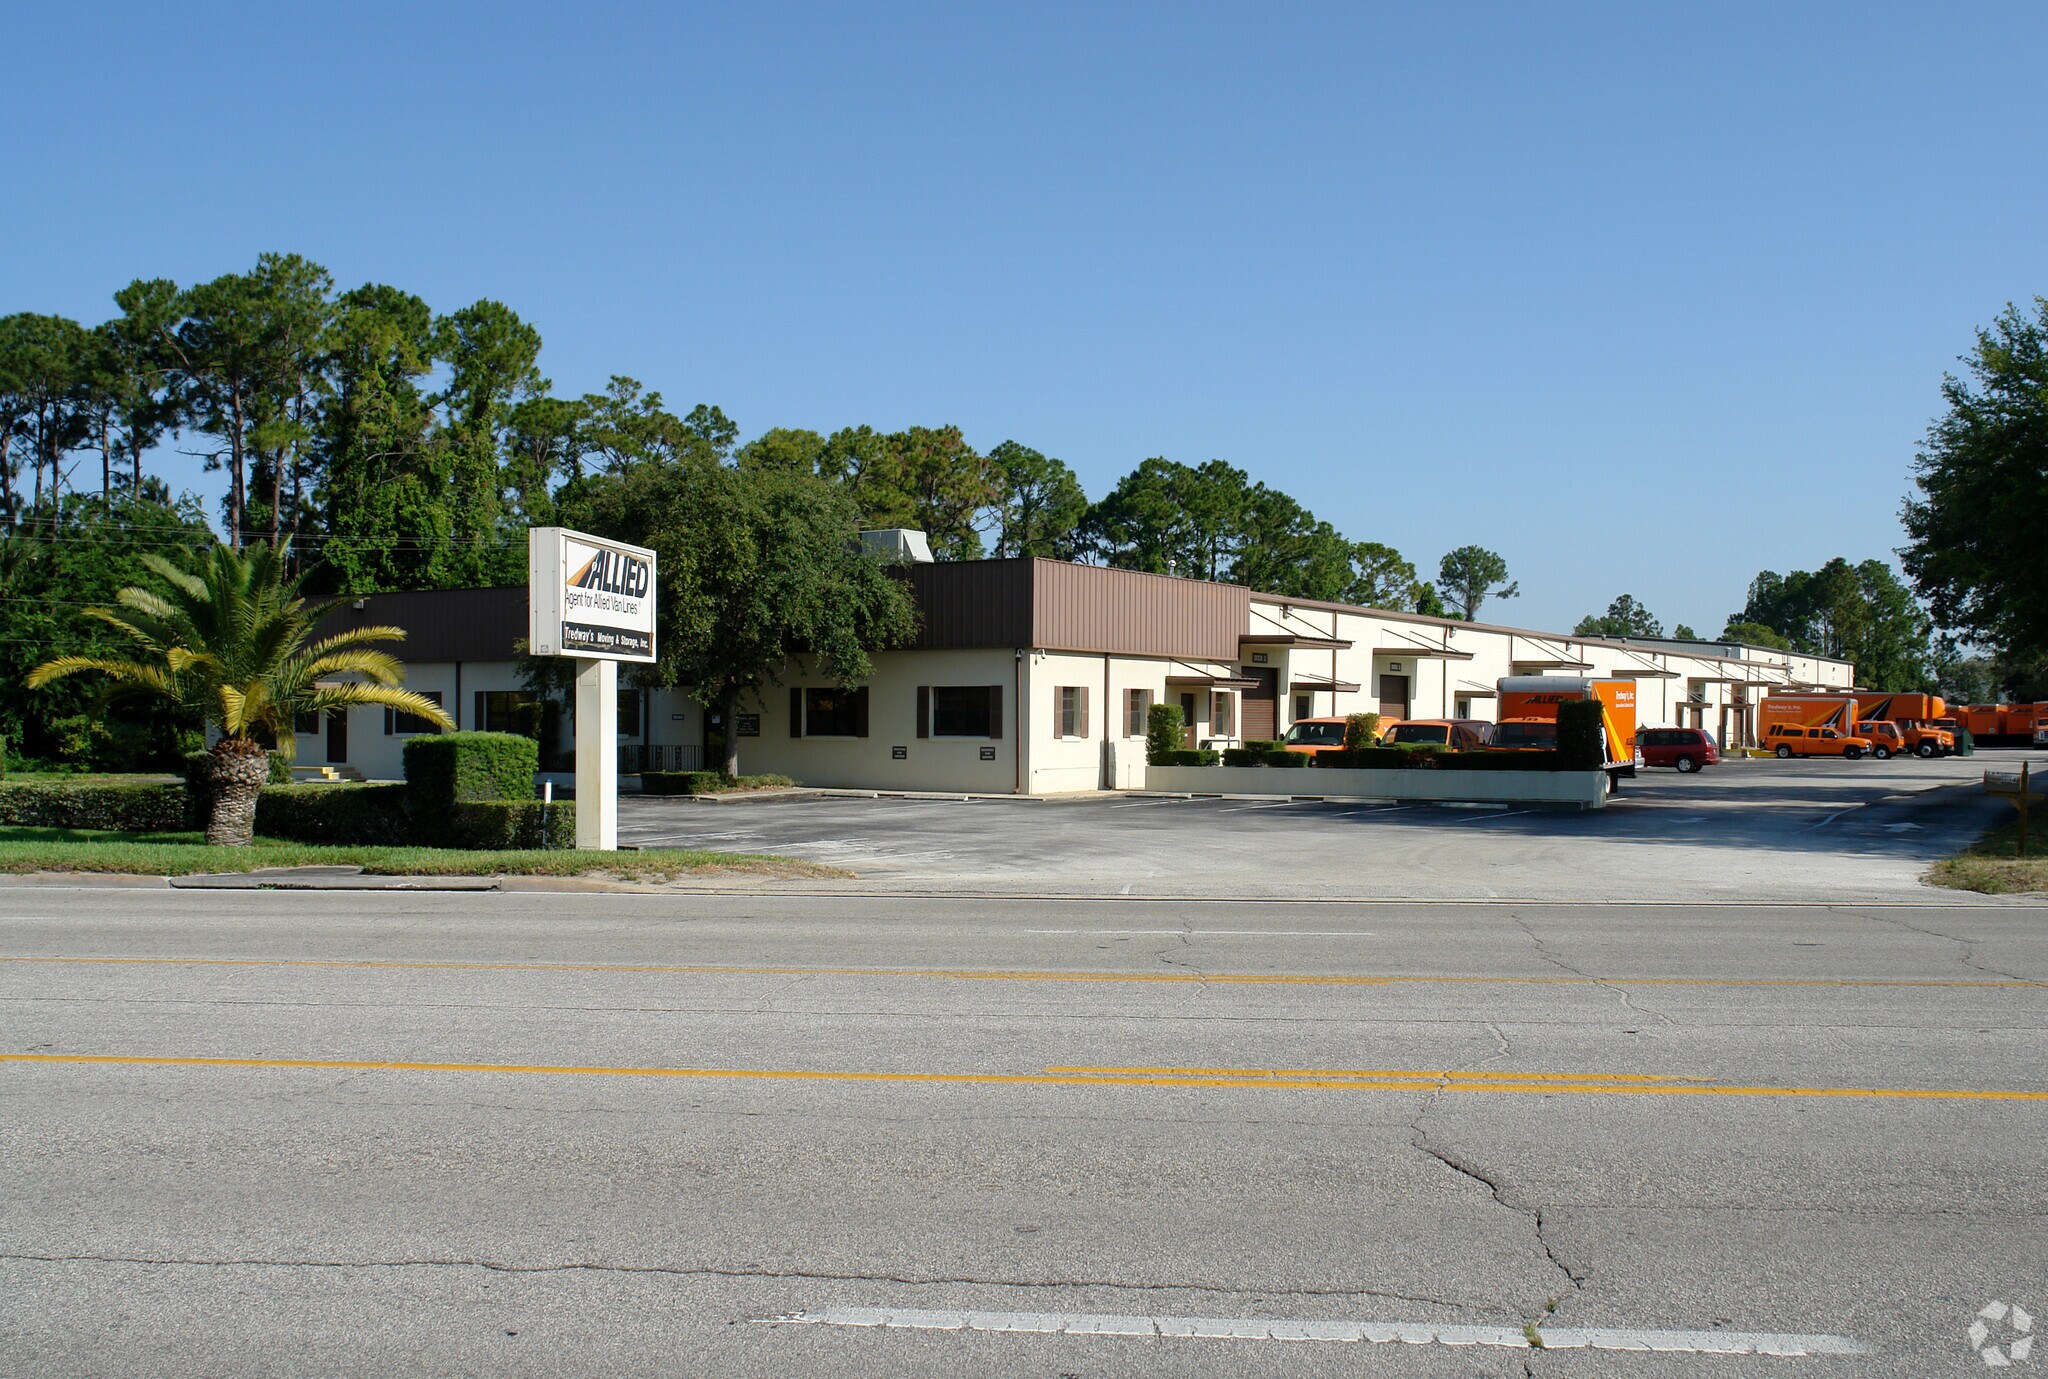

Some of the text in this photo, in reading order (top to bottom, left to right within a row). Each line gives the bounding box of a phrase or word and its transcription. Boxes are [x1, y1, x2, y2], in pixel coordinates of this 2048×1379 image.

[576, 549, 649, 599] ALLIED
[565, 590, 638, 615] Agent for Allied Van Lines
[565, 626, 649, 649] Tredway's Moving & Storage, Inc.
